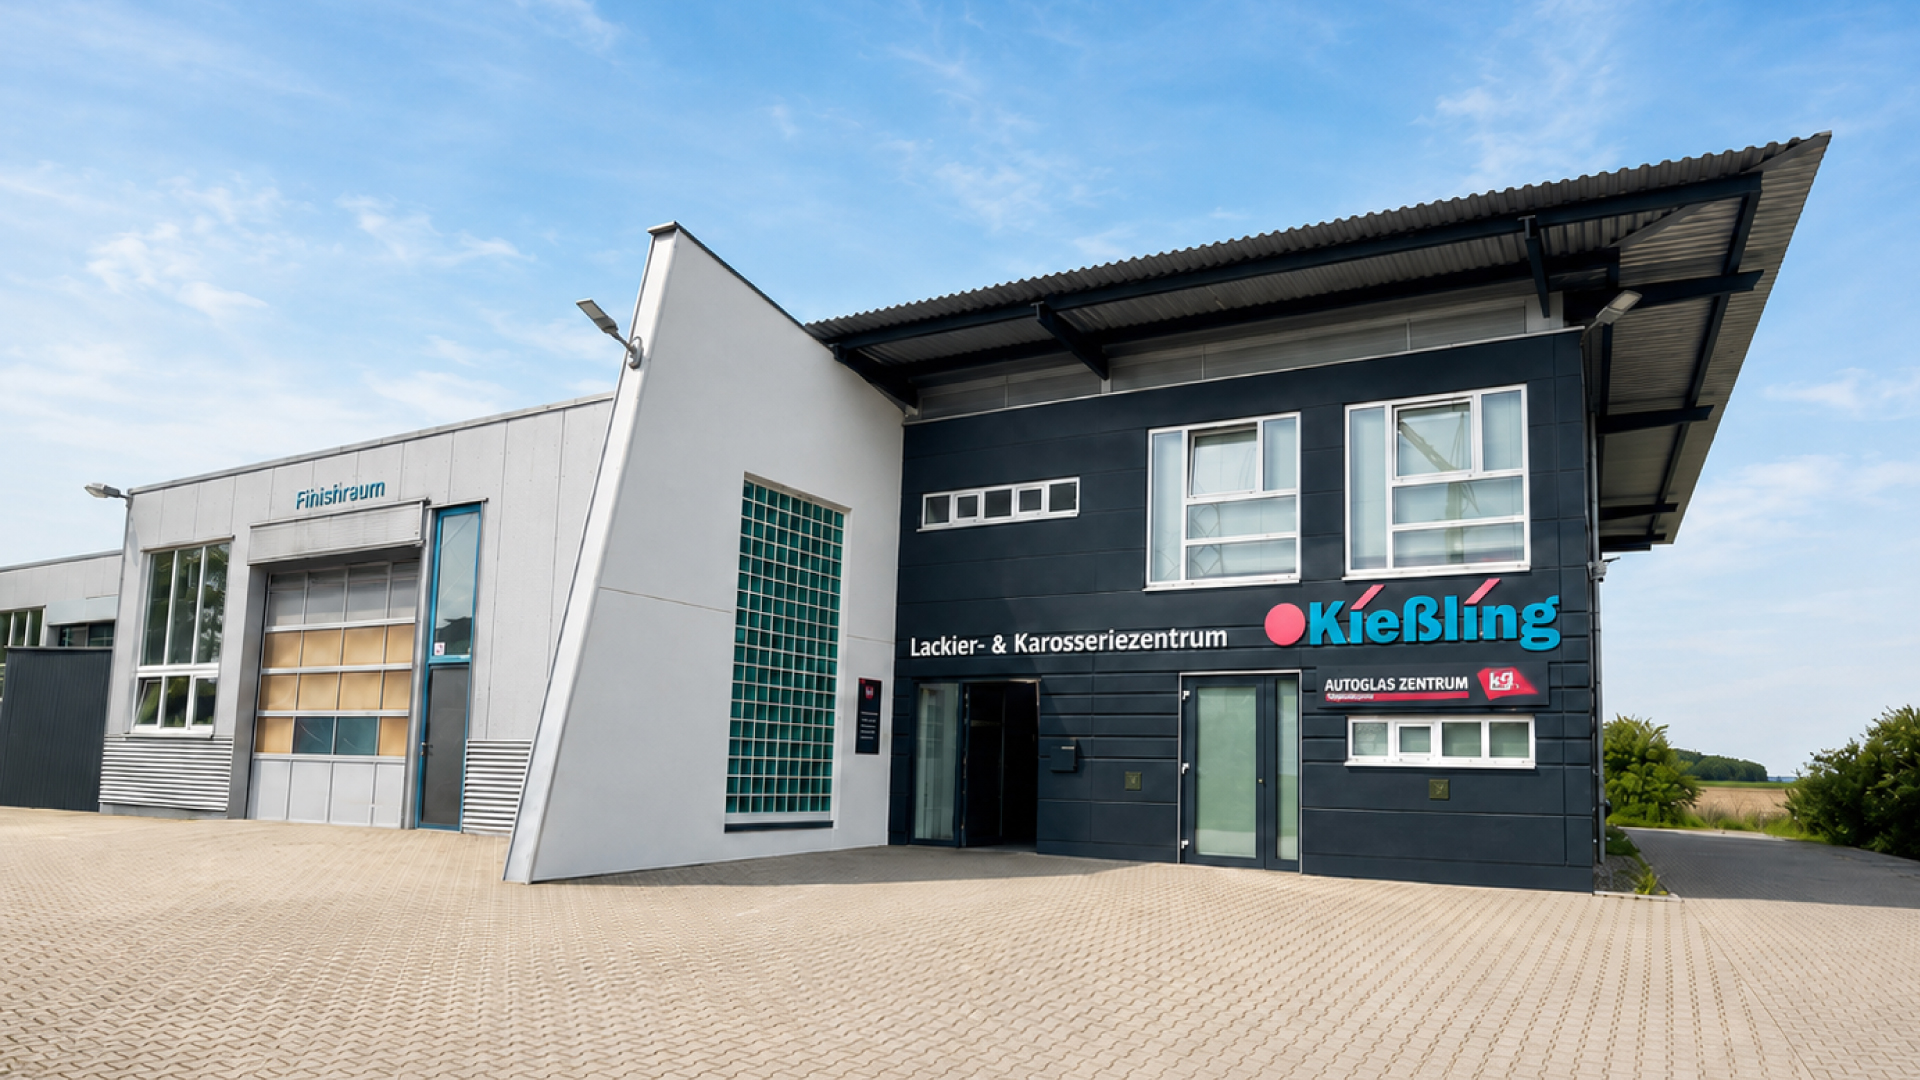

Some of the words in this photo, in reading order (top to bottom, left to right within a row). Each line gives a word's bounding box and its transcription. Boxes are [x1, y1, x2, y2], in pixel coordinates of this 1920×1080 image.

[911, 634, 985, 657] Lackier-
[991, 634, 1007, 655] &
[1014, 628, 1228, 654] Karosseriezentrum
[1324, 677, 1396, 692] AUTOGLAS
[1398, 676, 1468, 691] ZENTRUM
